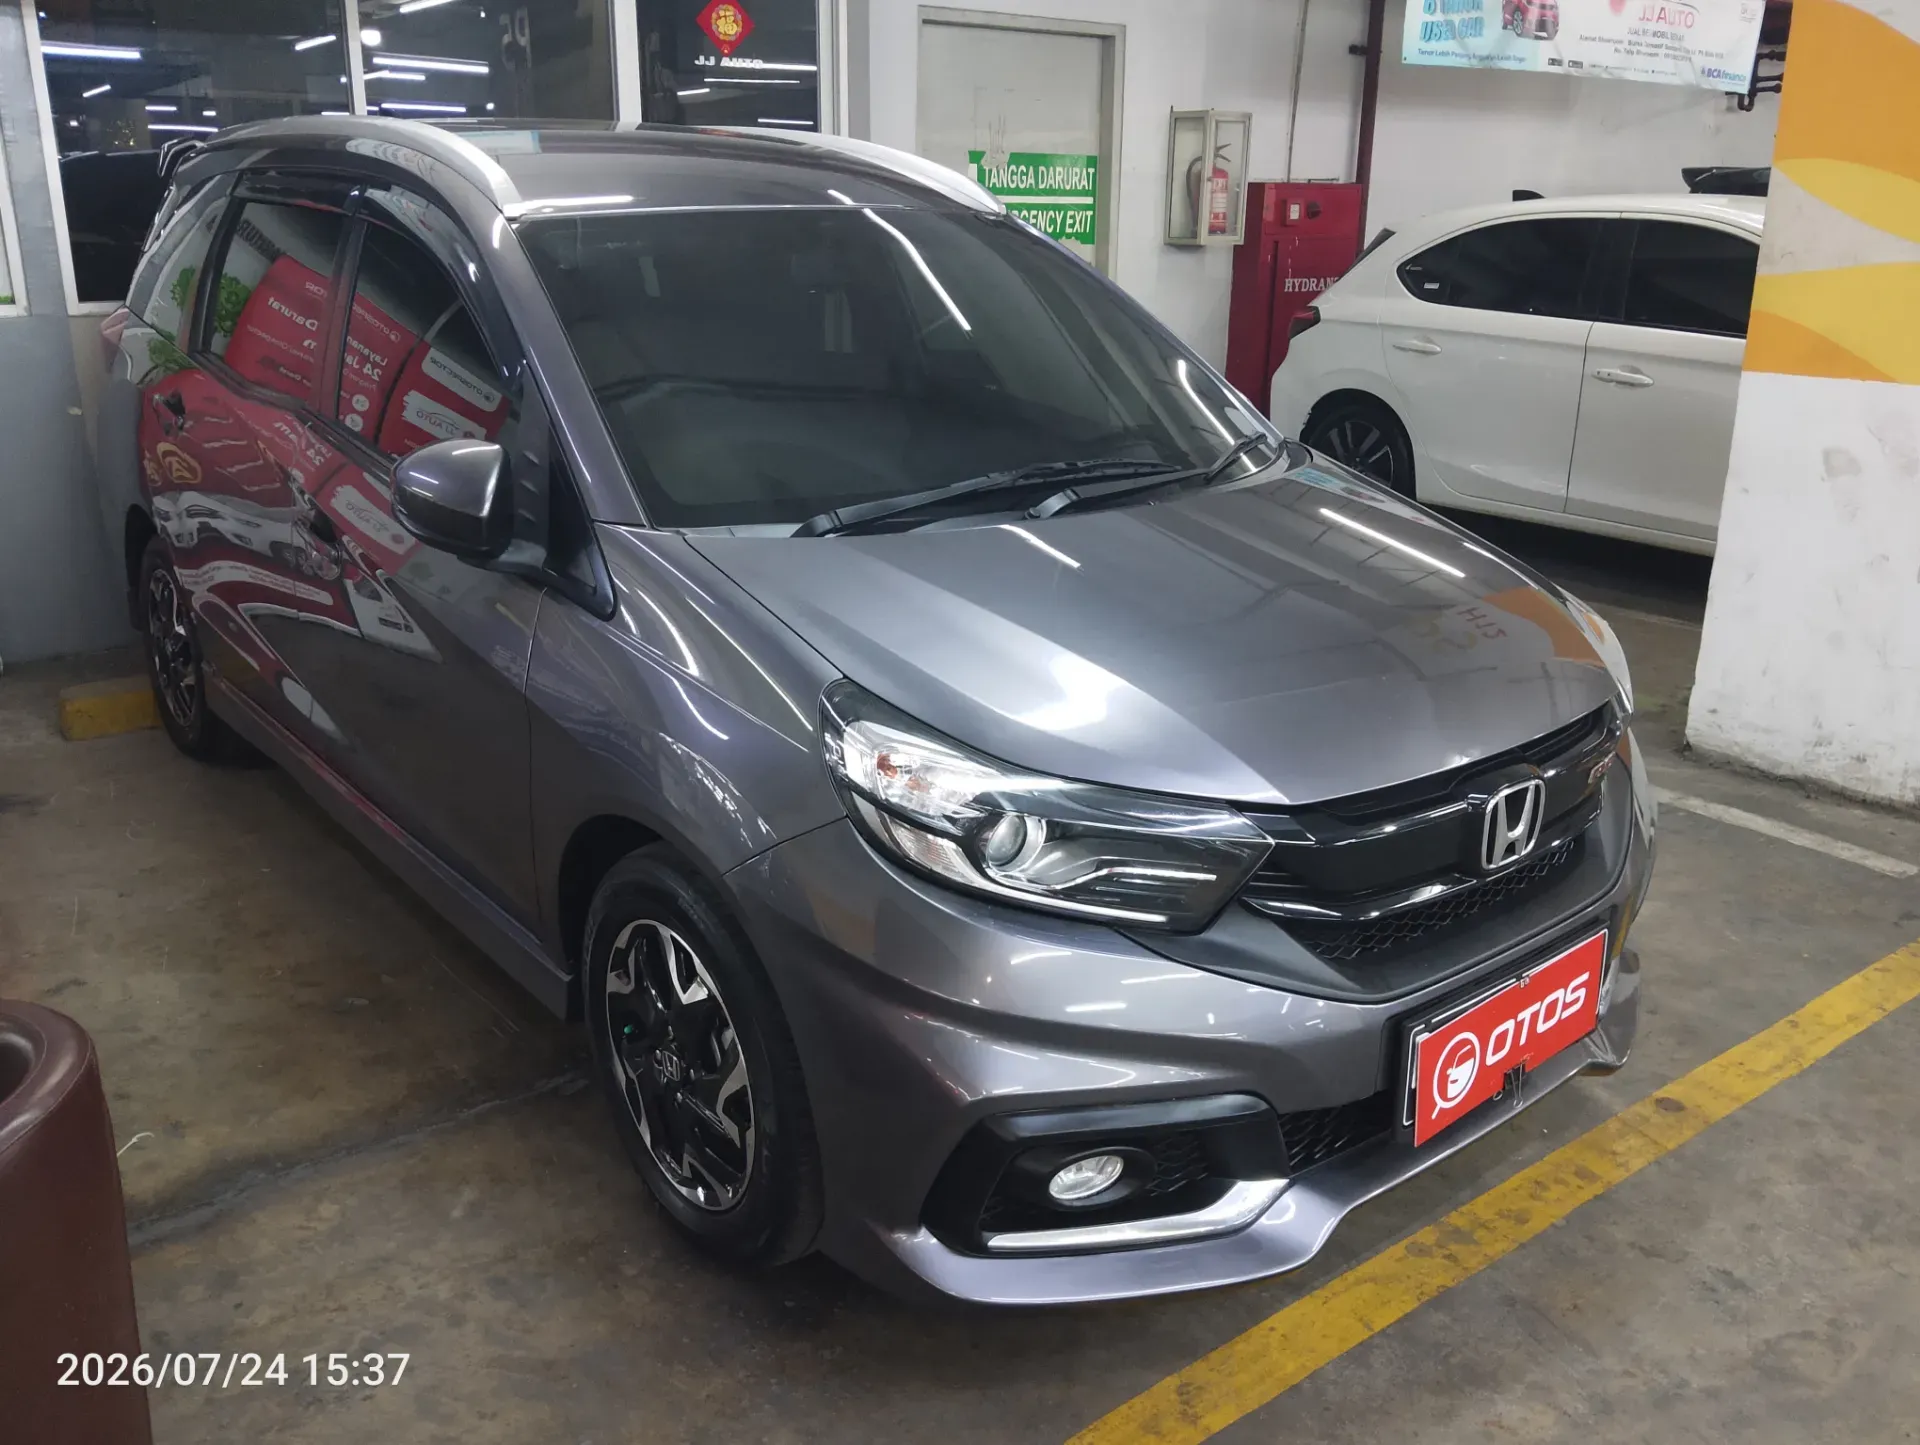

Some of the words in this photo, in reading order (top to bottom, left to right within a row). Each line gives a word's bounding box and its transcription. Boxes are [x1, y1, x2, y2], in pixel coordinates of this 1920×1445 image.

[1656, 7, 1695, 29] AUTO
[694, 55, 715, 67] JJ
[720, 56, 763, 69] AUTO
[985, 164, 1036, 189] TANGGA
[1039, 166, 1095, 190] DARURAT
[1065, 210, 1094, 233] EXIT
[1284, 276, 1340, 292] HYDRAN
[1486, 971, 1590, 1067] OTOS
